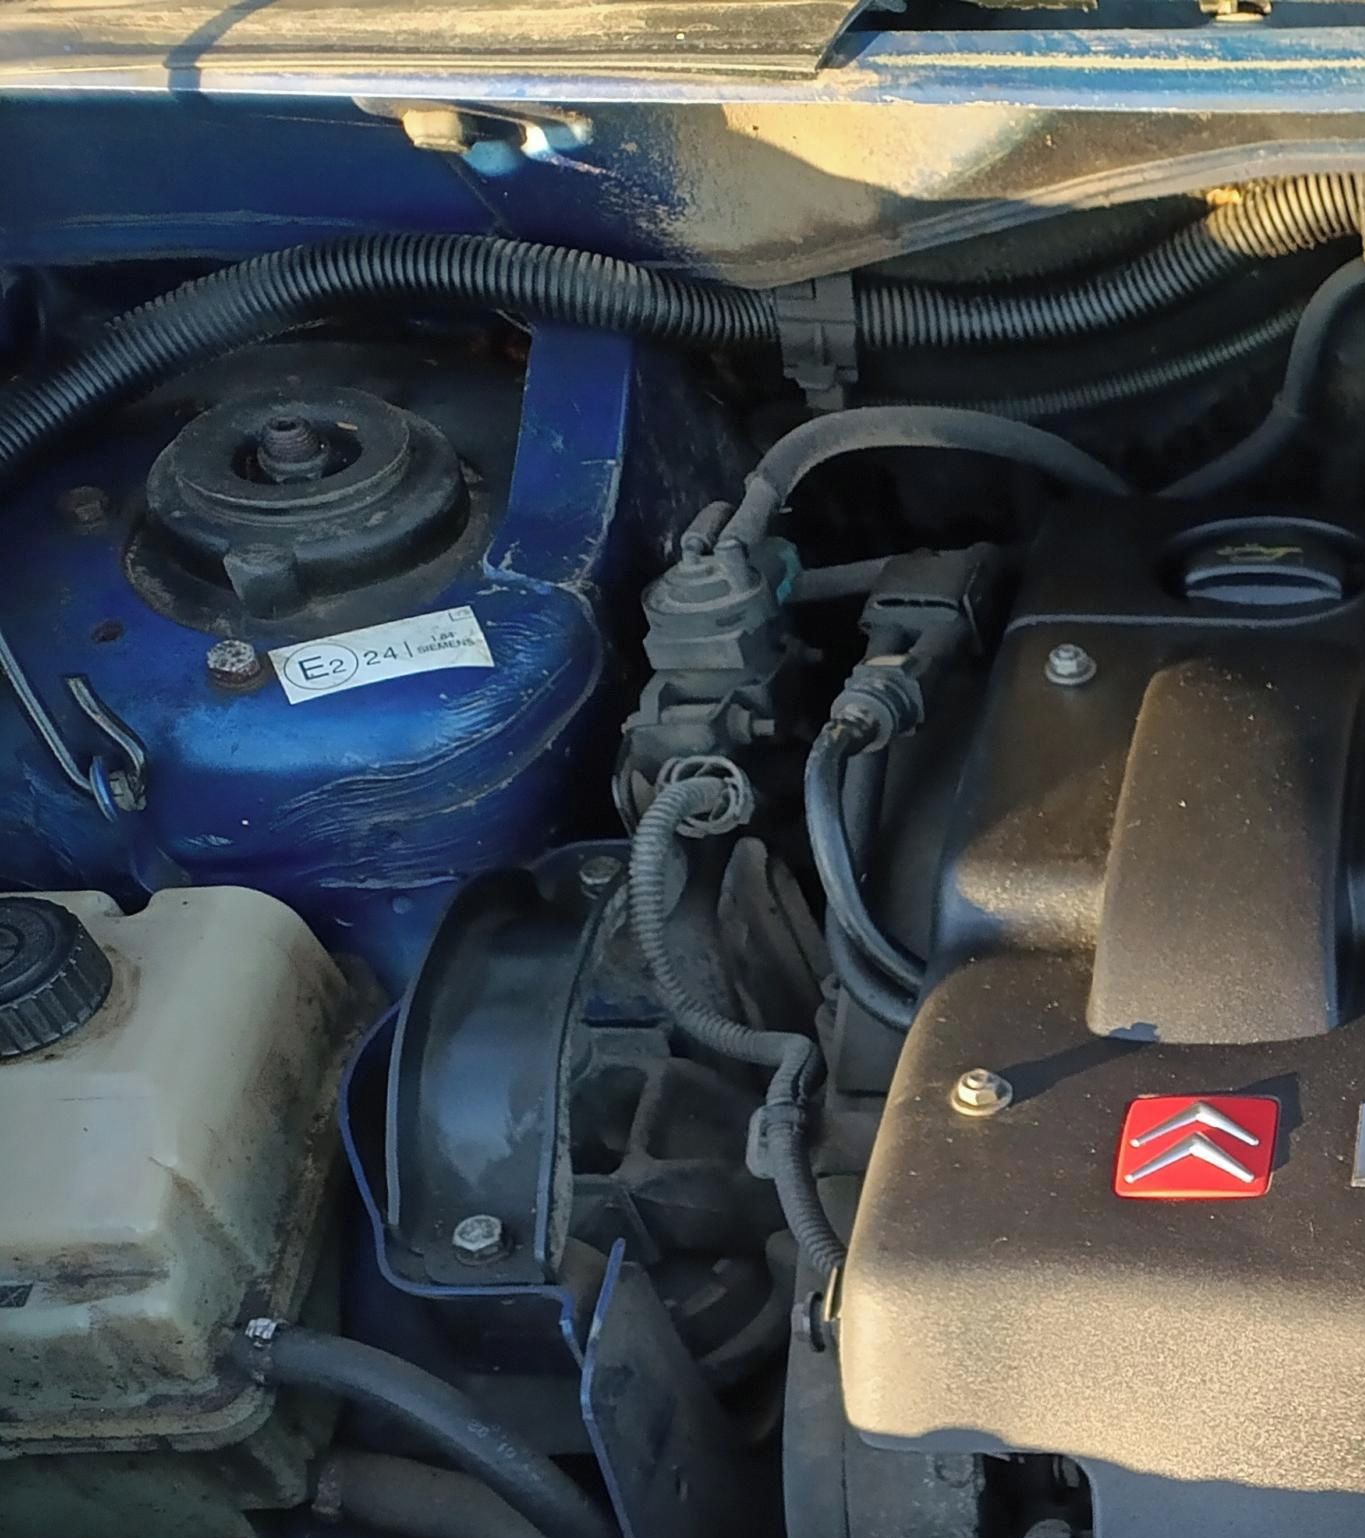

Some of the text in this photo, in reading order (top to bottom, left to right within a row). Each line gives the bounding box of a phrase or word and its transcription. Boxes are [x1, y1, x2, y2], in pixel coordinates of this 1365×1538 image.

[416, 638, 476, 654] SIEMENS
[298, 646, 398, 681] E2 24
